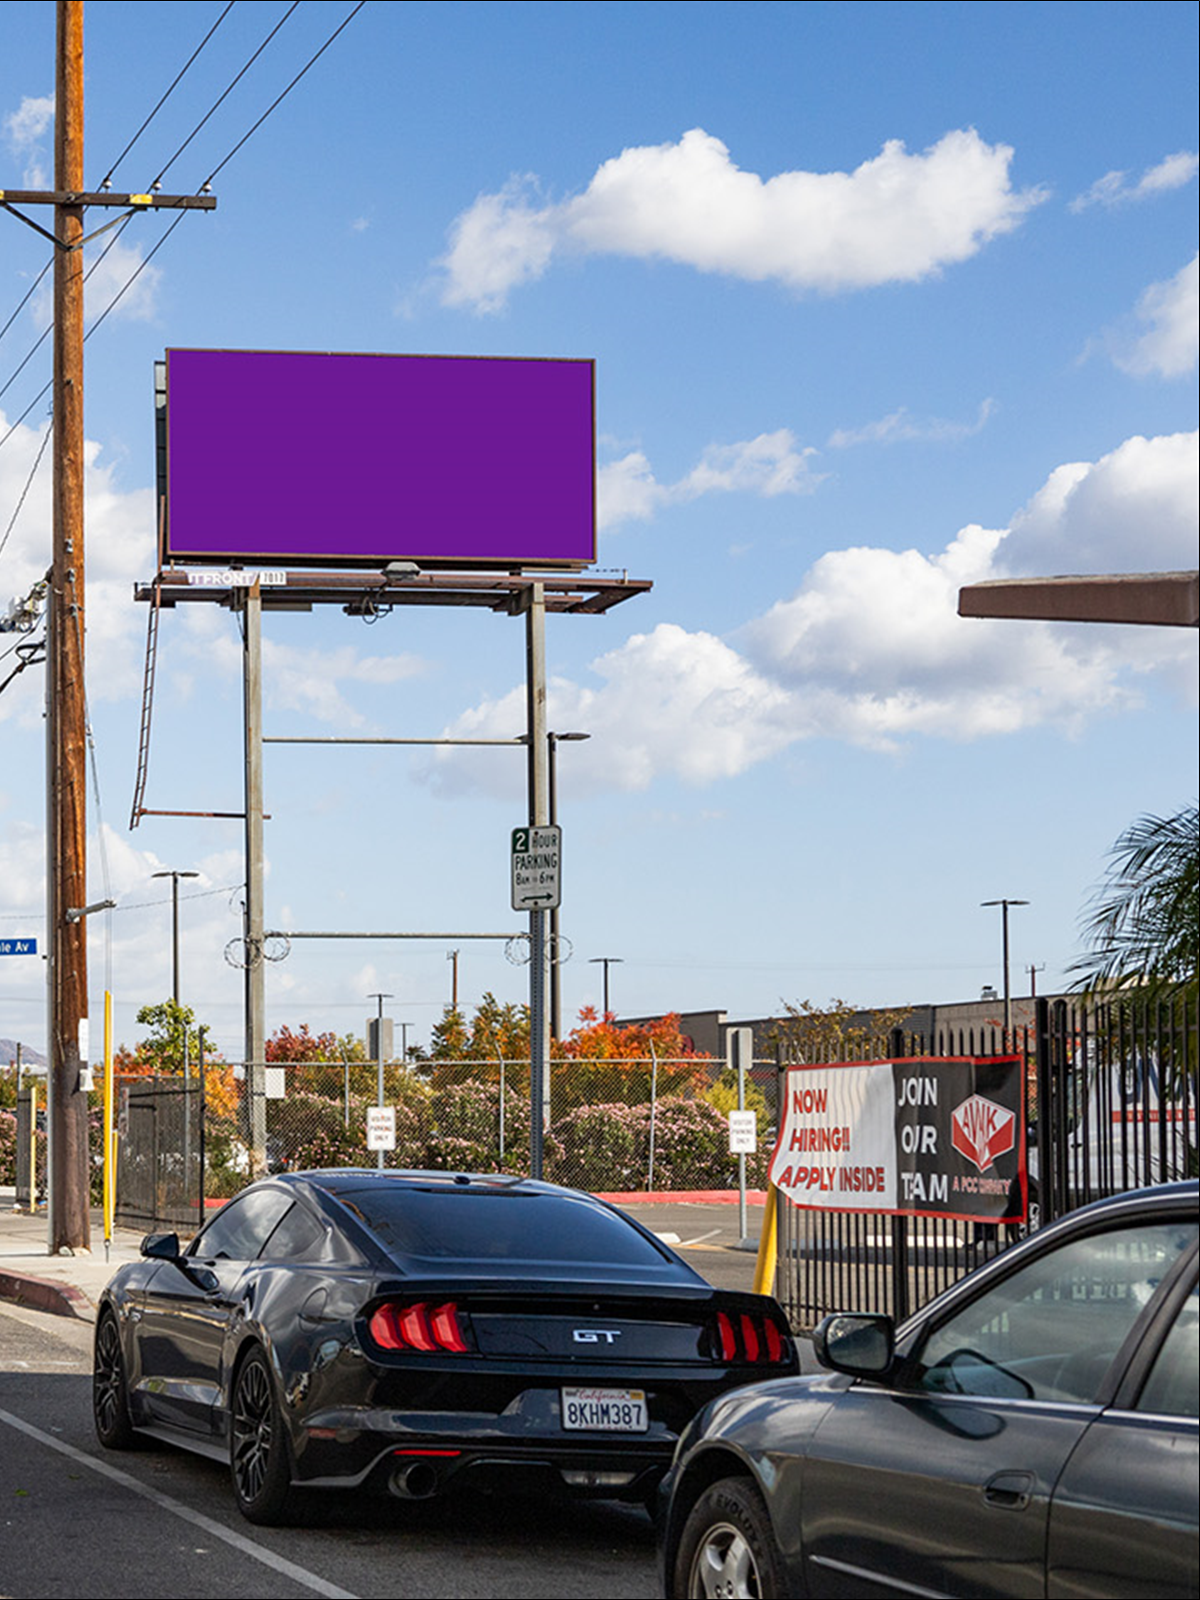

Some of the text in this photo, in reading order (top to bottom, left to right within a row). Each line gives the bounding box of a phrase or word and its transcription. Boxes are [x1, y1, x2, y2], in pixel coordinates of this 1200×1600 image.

[515, 832, 558, 851] 2 HOUR
[515, 853, 558, 871] PARKING
[15, 941, 30, 952] Av
[793, 1089, 828, 1114] NOW
[898, 1077, 938, 1106] JOIN
[789, 1127, 851, 1152] HIRING!!
[777, 1165, 886, 1192] APPLY INSIDE
[901, 1172, 949, 1203] TAM
[952, 1176, 960, 1192] A
[572, 1329, 622, 1343] GT
[567, 1402, 643, 1426] 8KHM387
